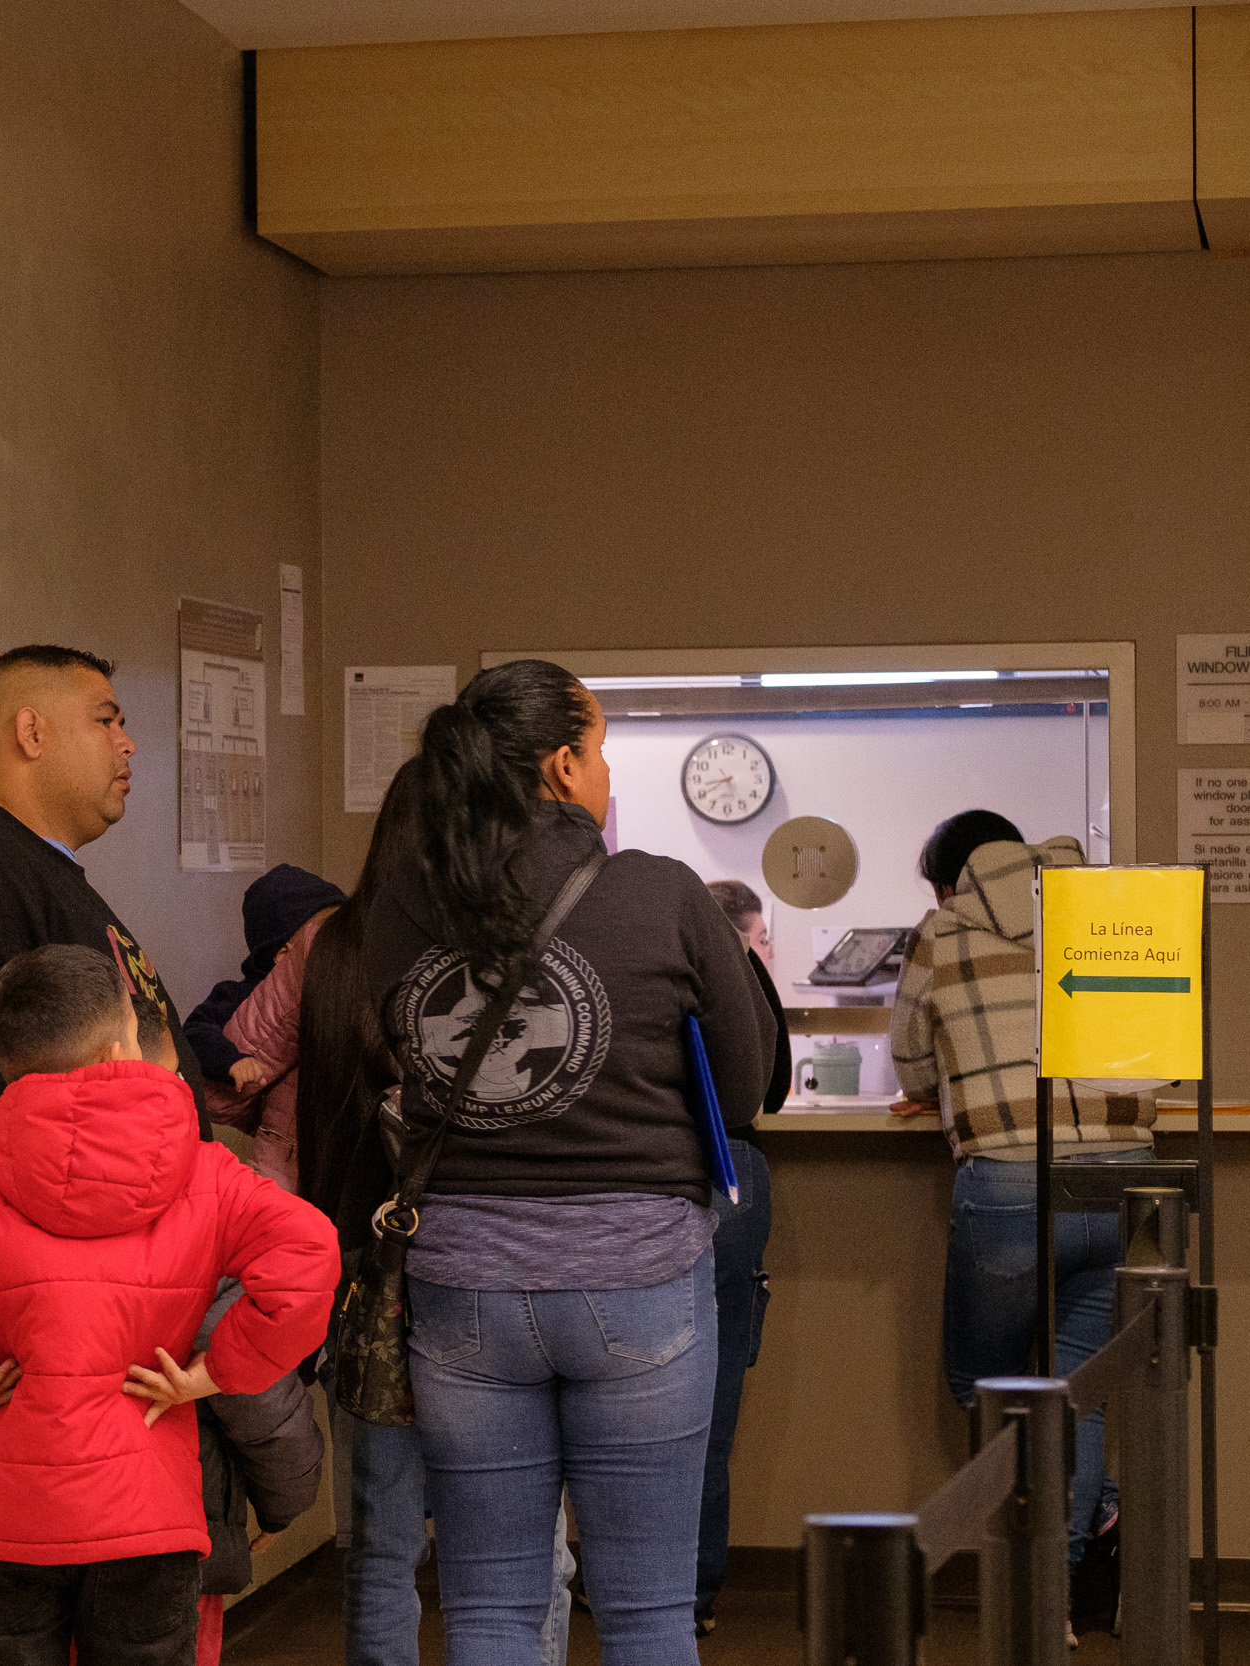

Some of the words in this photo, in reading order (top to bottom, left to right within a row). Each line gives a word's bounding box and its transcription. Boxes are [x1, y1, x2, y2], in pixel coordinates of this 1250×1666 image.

[1225, 646, 1250, 657] FILI
[1225, 698, 1240, 708] AM
[722, 744, 734, 755] 12
[696, 761, 709, 771] 10
[750, 760, 758, 771] 2
[693, 774, 701, 785] 9
[1196, 777, 1202, 787] If
[1207, 779, 1222, 788] no
[1226, 779, 1248, 788] one
[698, 790, 706, 799] 8
[750, 789, 757, 799] 4
[1193, 790, 1236, 801] window
[710, 800, 716, 810] 7
[723, 803, 732, 815] 6
[738, 800, 746, 811] 5
[1209, 816, 1225, 826] for
[1194, 843, 1205, 855] Si
[1210, 844, 1240, 855] nadie
[1211, 884, 1229, 893] ara
[1090, 922, 1107, 936] La
[1112, 921, 1153, 936] Línea
[1063, 946, 1139, 961] Comienza
[1144, 947, 1181, 964] Aquí
[410, 1051, 434, 1083] NAVY
[539, 952, 587, 1001] RAINING
[566, 1002, 592, 1073] COMMAND
[494, 1083, 563, 1115] LEJEUNE
